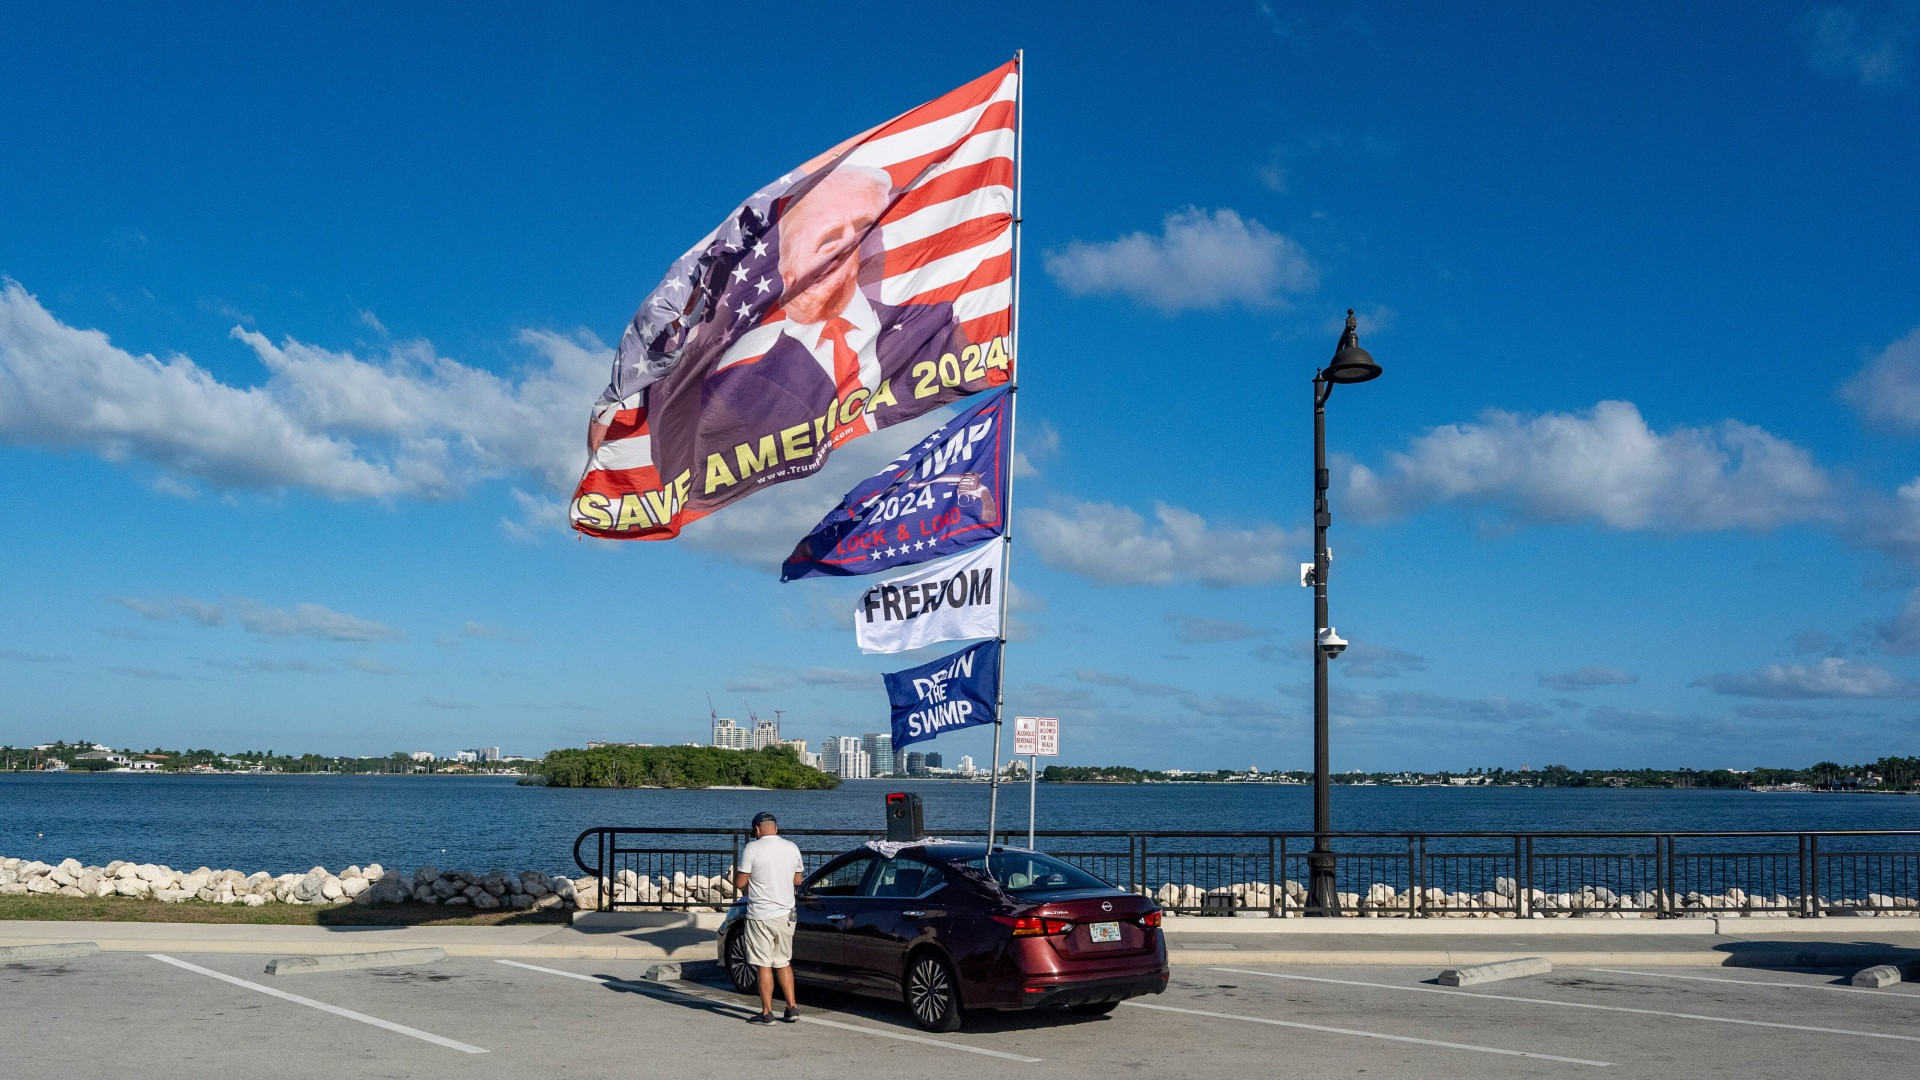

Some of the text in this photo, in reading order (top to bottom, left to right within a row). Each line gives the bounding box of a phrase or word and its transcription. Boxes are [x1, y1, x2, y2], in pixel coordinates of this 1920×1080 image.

[577, 468, 692, 531] SAVE
[911, 336, 1009, 400] 2024
[868, 484, 936, 526] 2024
[837, 529, 887, 555] LOCK
[897, 523, 911, 541] &
[925, 683, 948, 705] THE
